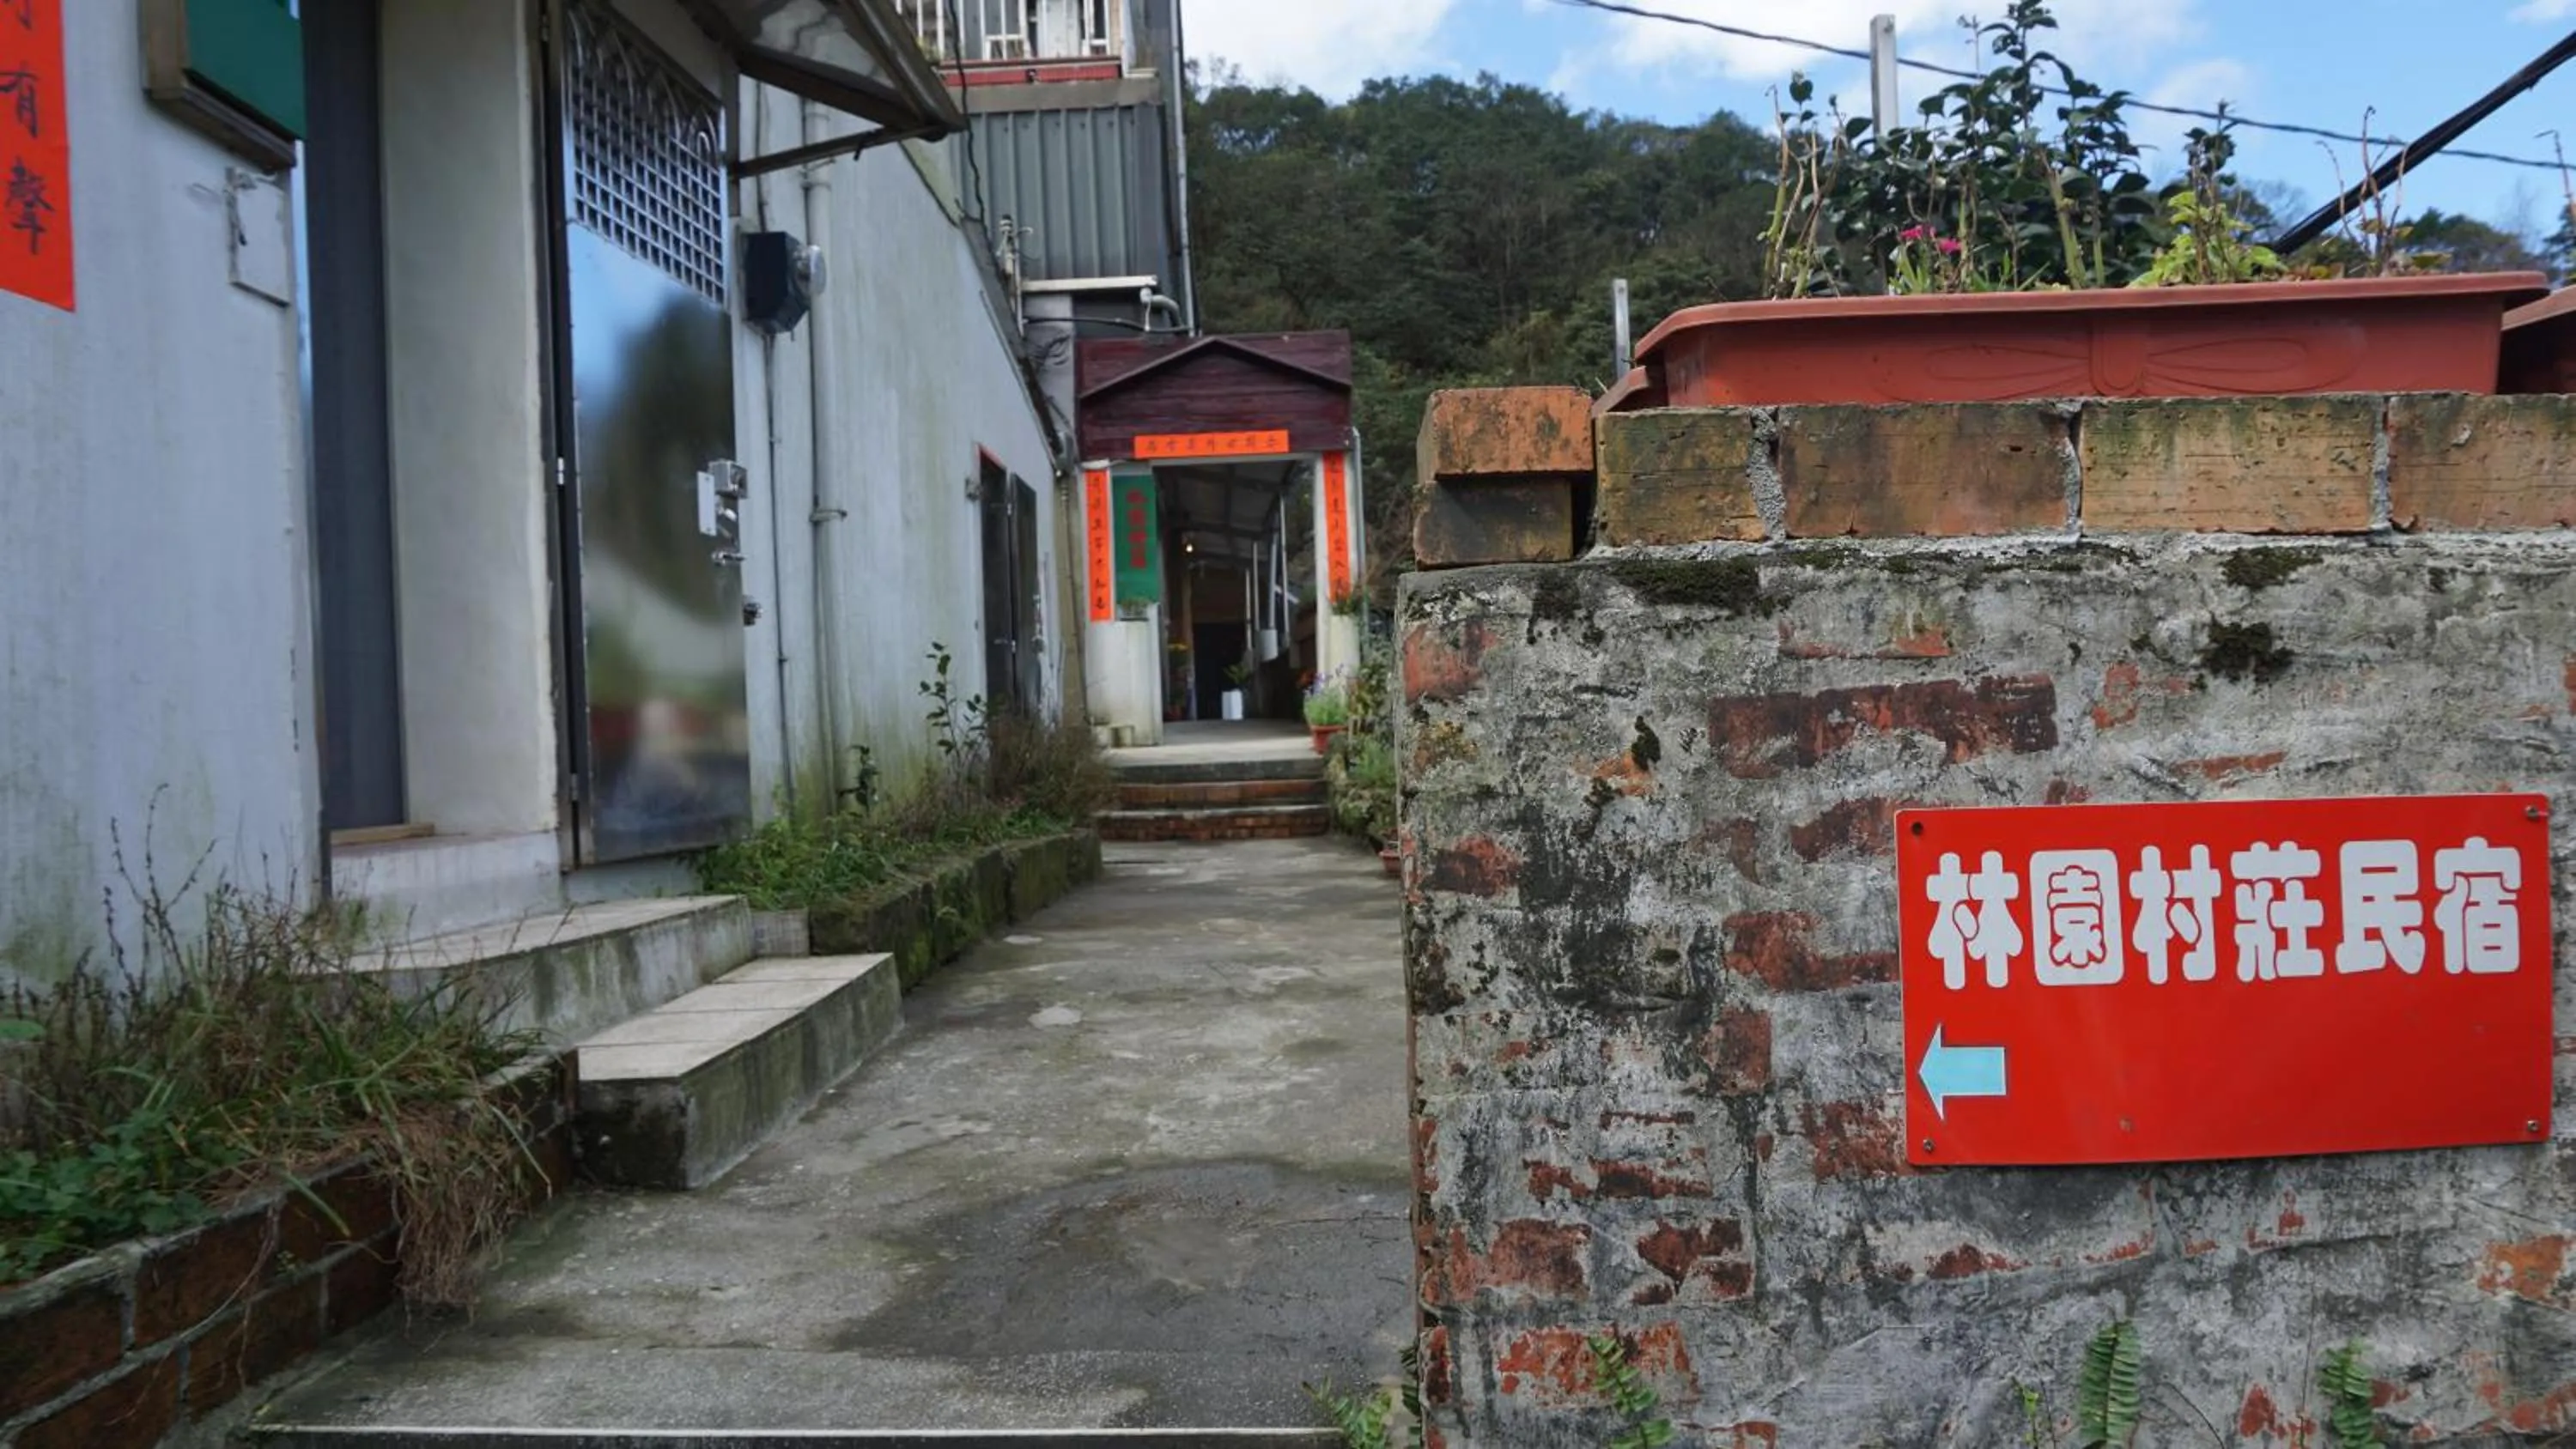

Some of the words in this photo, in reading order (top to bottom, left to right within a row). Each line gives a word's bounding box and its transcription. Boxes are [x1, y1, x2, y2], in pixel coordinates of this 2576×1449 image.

[1926, 836, 2523, 990] 林園村莊民宿
